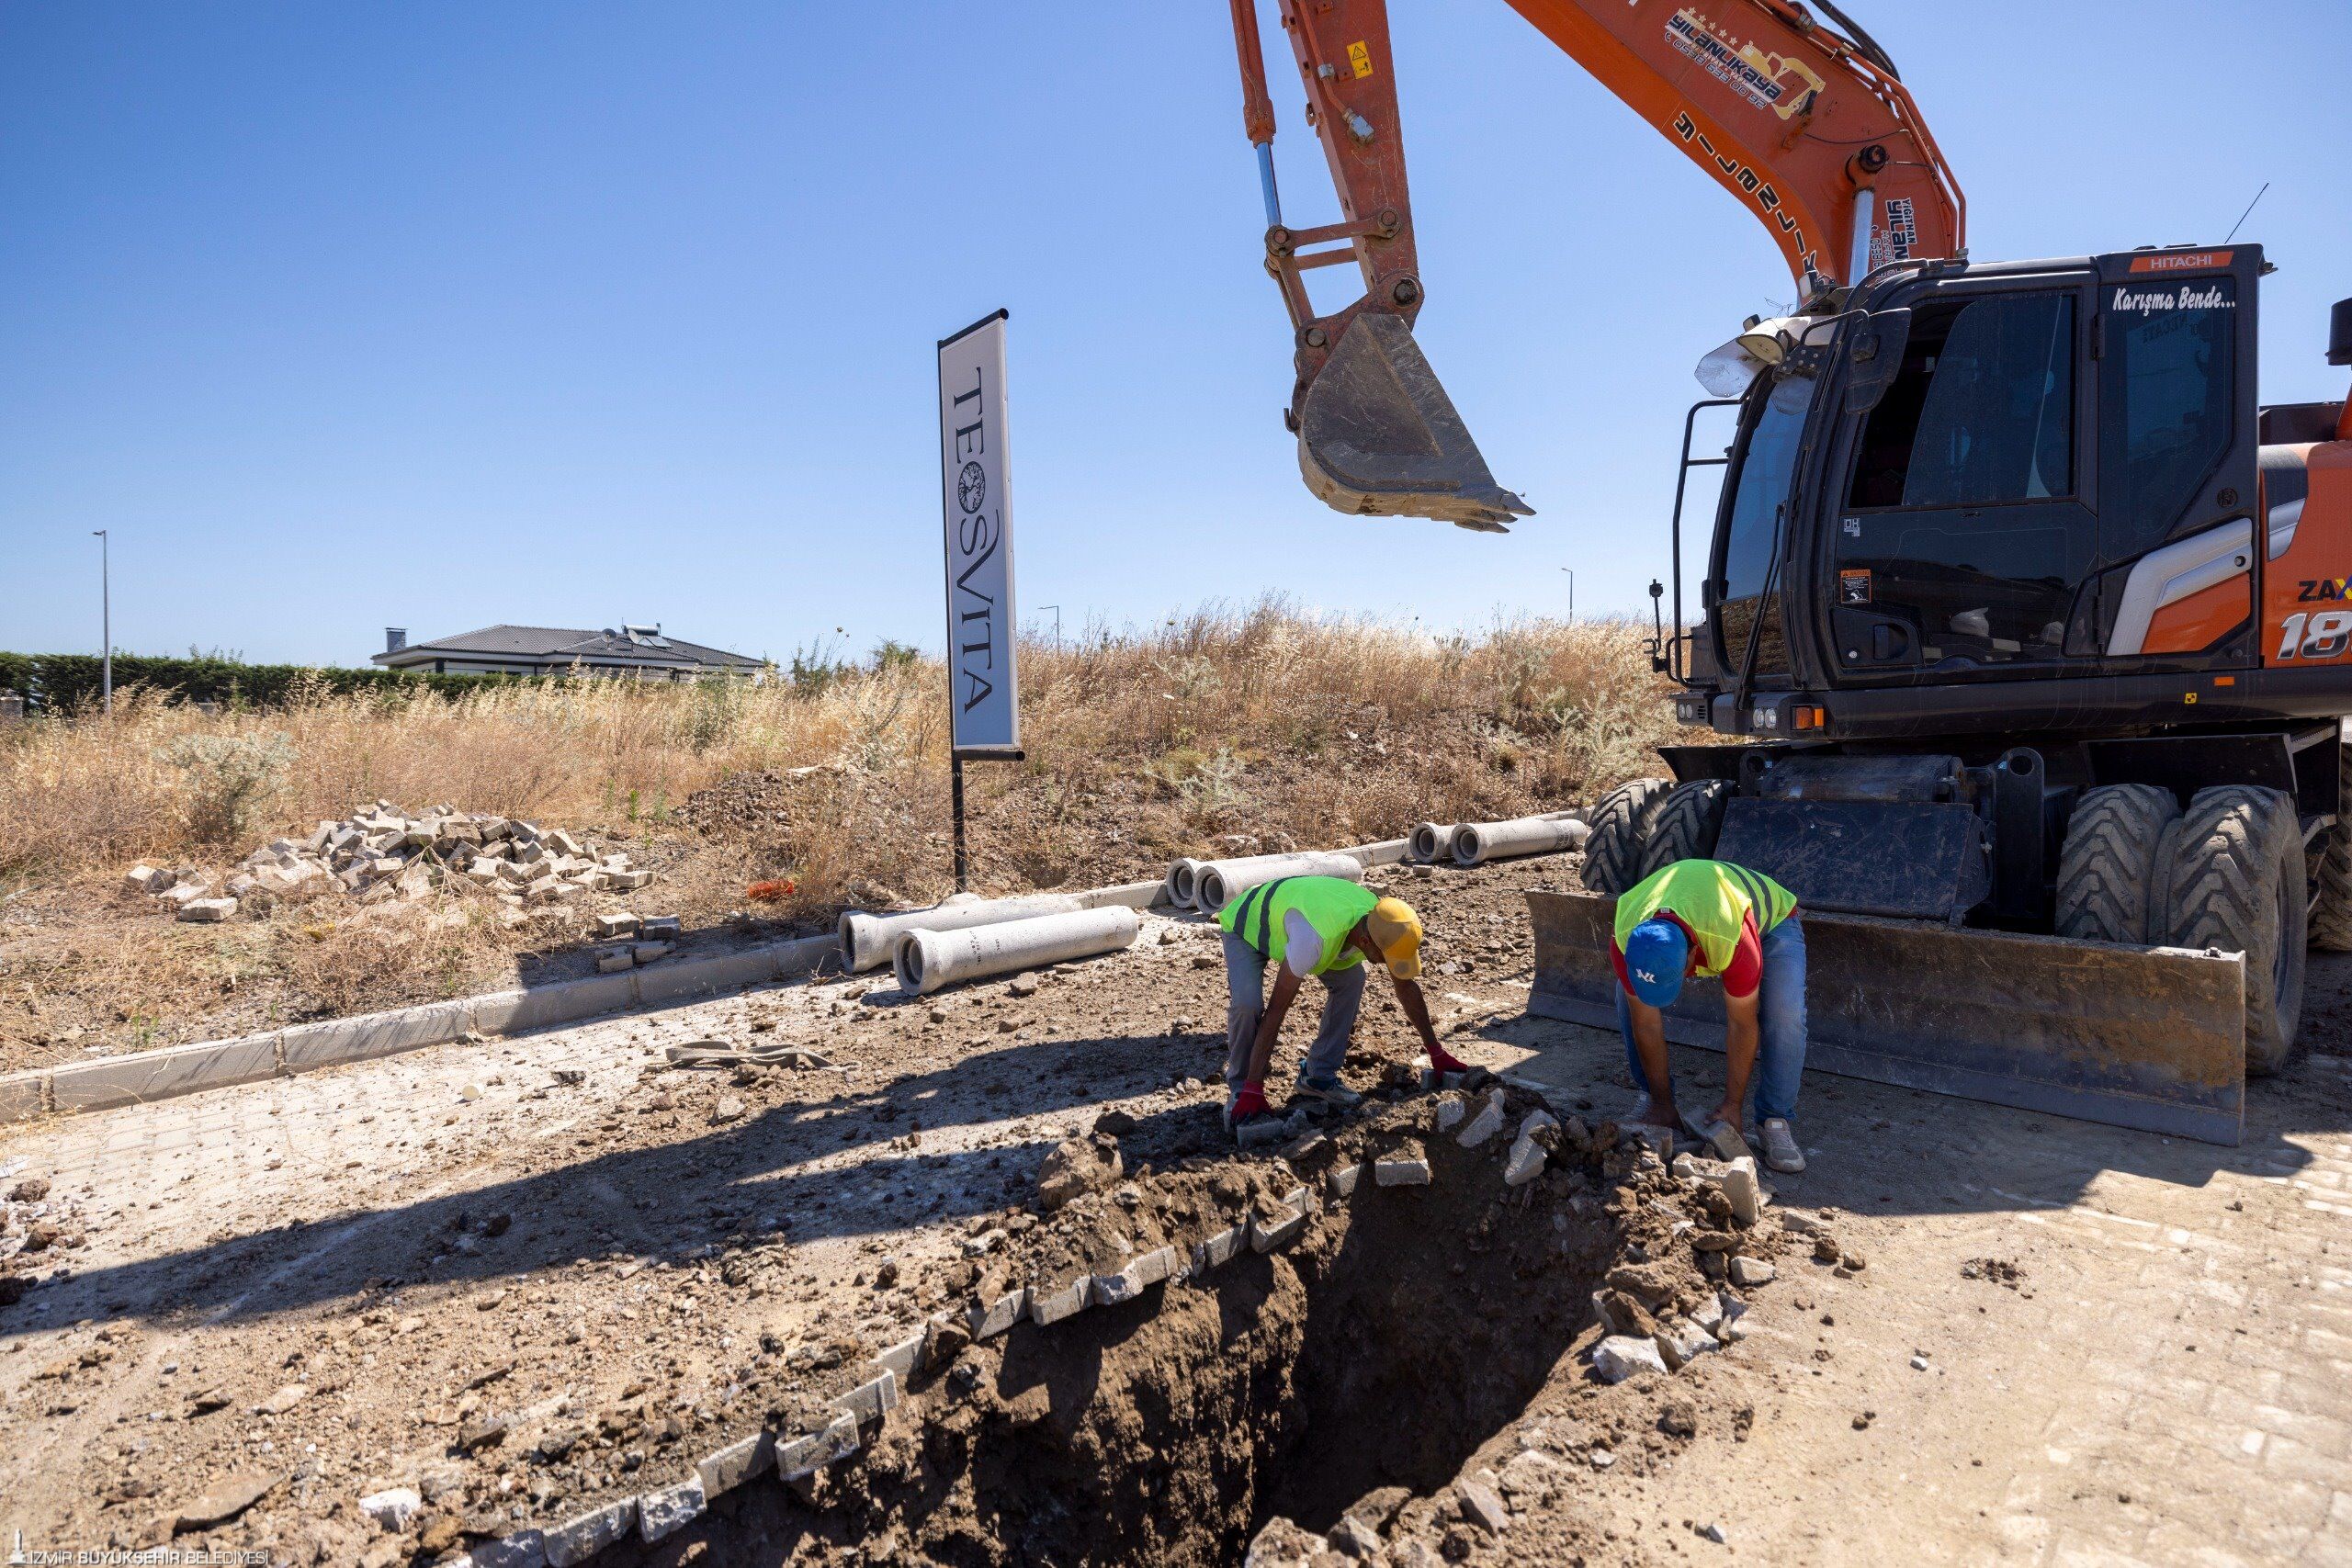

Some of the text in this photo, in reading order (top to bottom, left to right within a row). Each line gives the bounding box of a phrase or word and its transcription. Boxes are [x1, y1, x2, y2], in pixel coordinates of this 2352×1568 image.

[1730, 81, 1748, 96] 00
[2151, 254, 2212, 268] HITACHI
[2113, 285, 2235, 316] Karışma Bende...
[2277, 611, 2352, 660] 18
